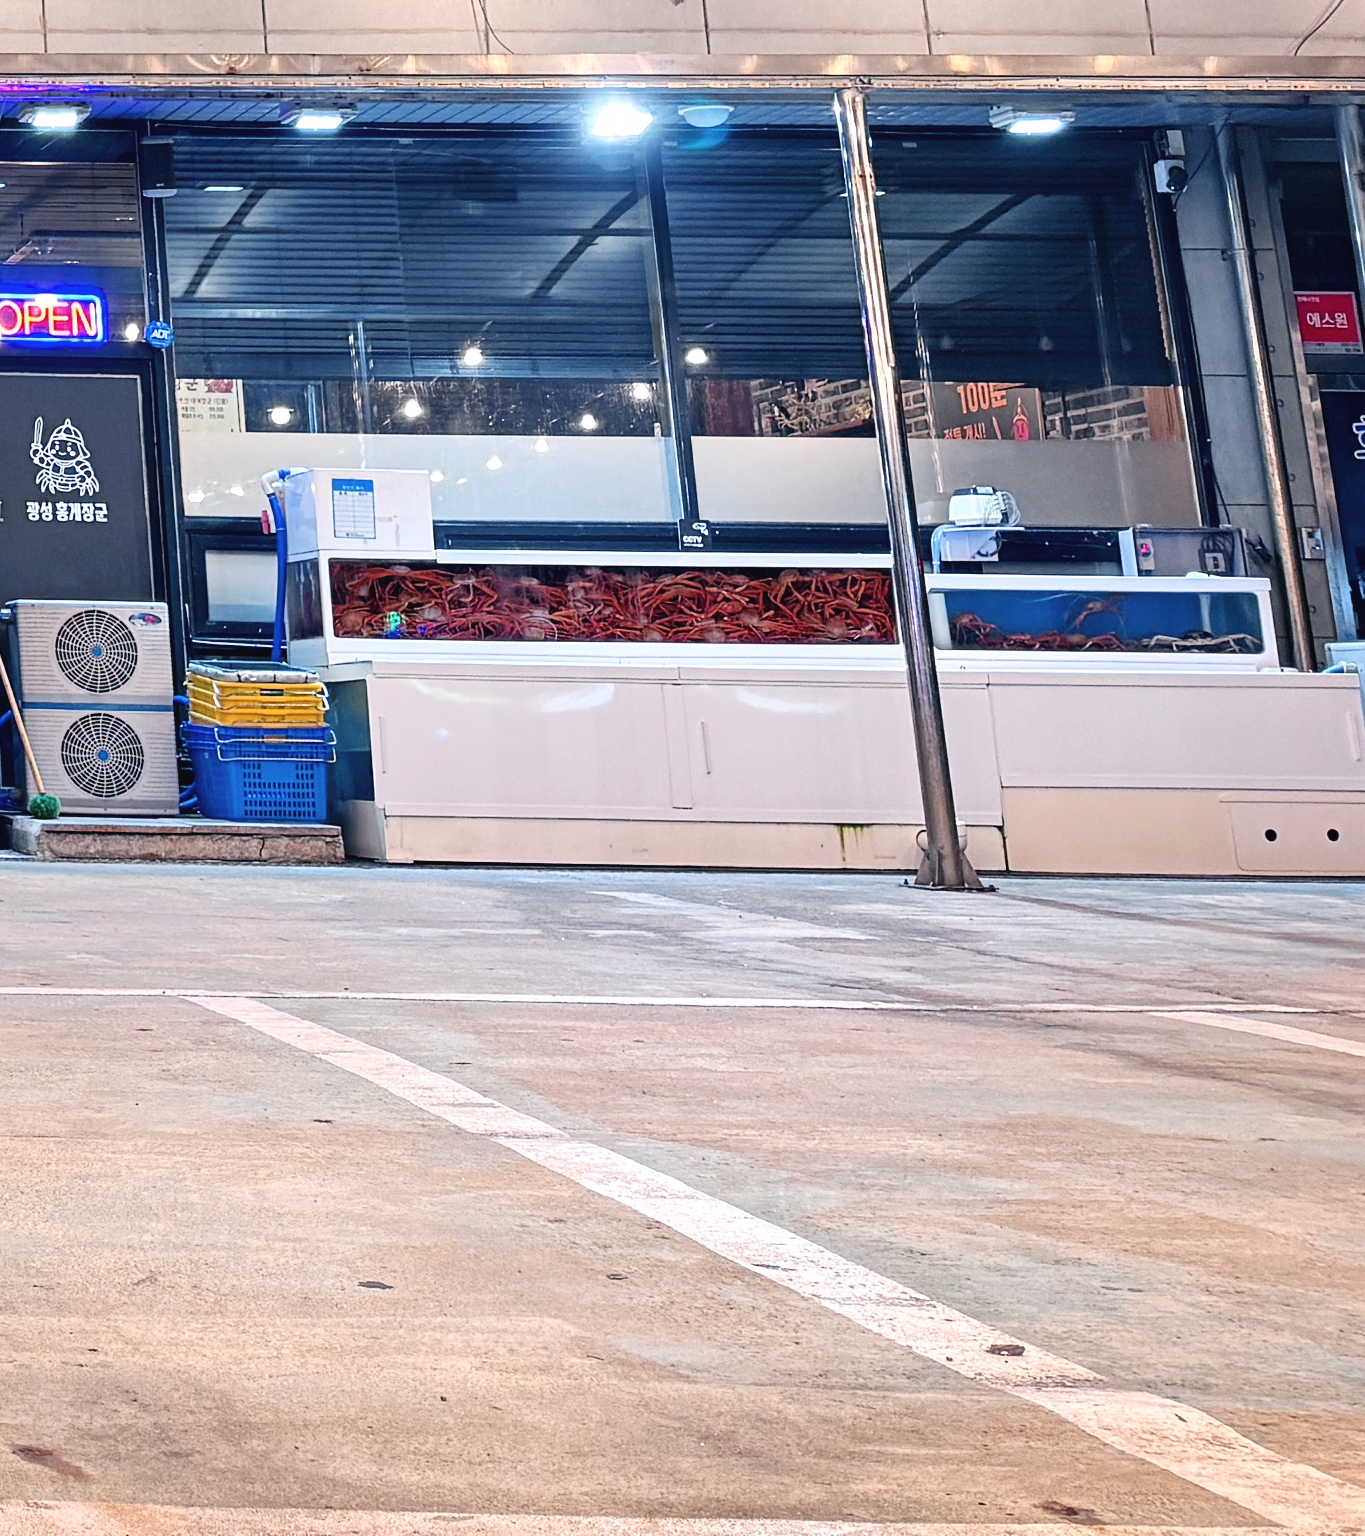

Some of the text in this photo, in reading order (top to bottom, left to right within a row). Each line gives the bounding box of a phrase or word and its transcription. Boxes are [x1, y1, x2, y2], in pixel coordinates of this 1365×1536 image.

[1306, 312, 1349, 329] 에스원
[150, 329, 169, 339] ADT
[26, 501, 108, 522] 광성 홍게장군
[682, 535, 702, 543] CCTV
